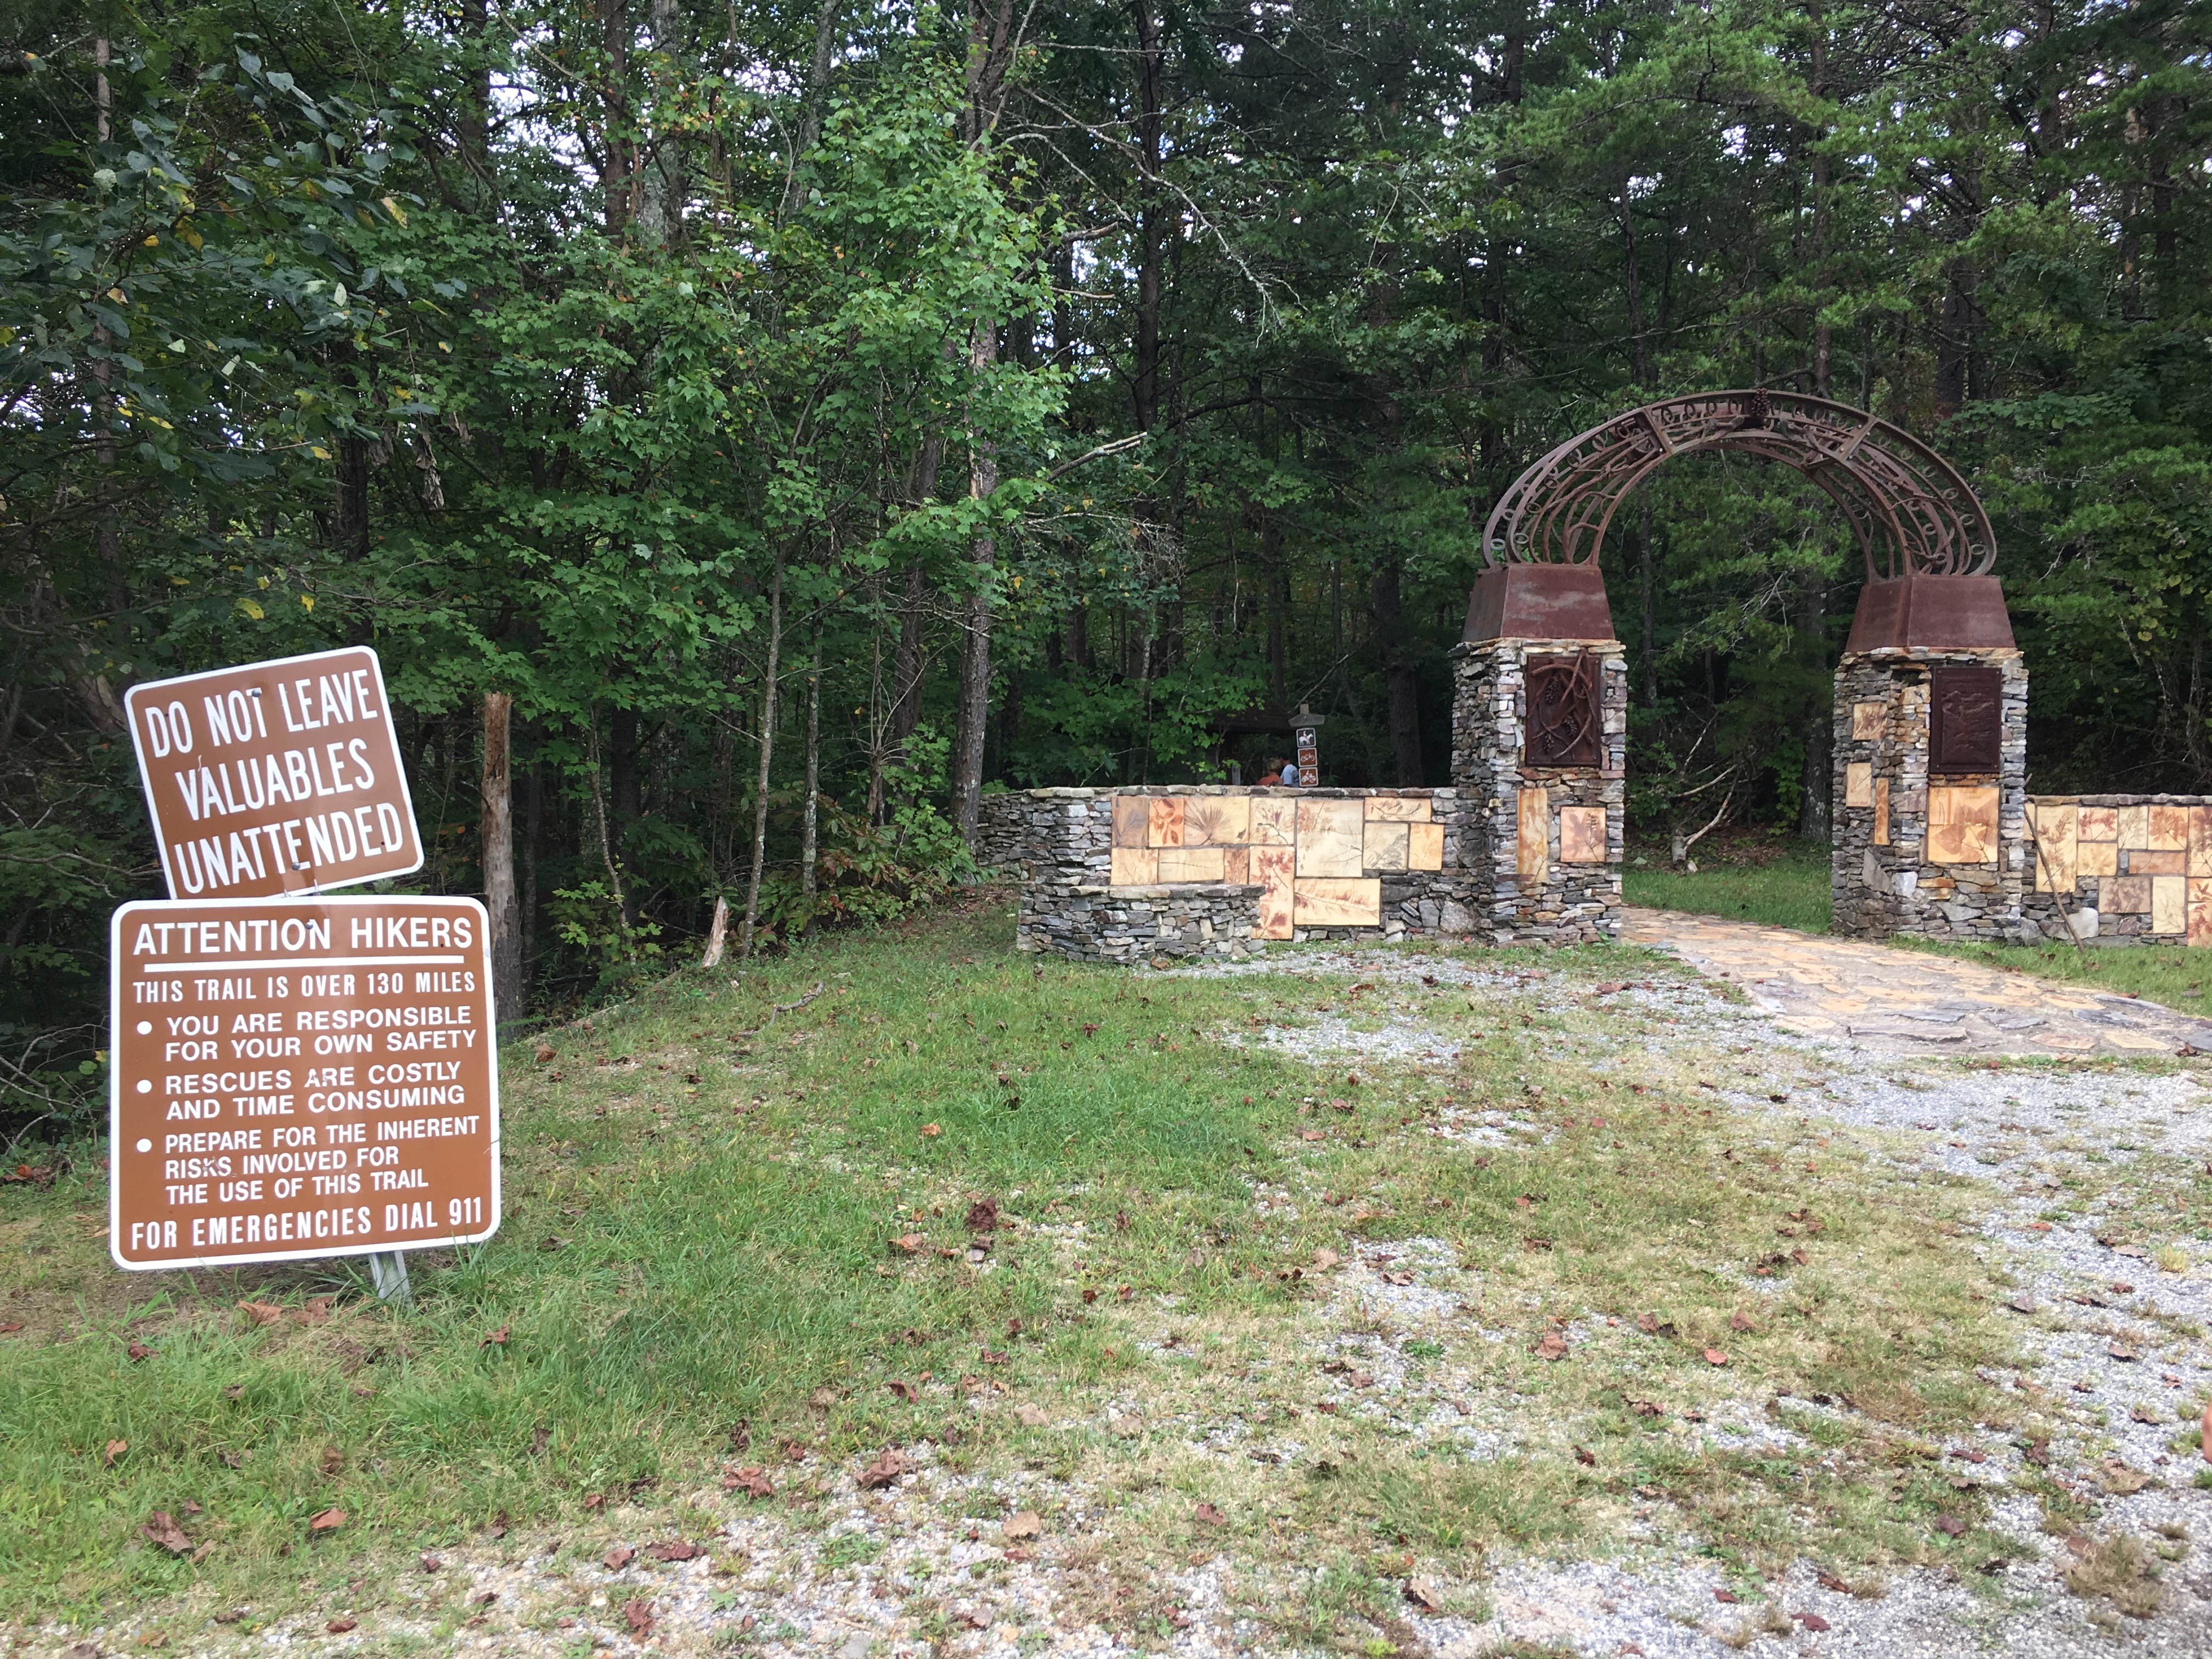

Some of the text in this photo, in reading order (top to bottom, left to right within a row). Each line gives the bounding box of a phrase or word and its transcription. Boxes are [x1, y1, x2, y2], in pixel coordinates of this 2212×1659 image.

[145, 669, 377, 757] DO NOT LEAVE
[175, 738, 374, 820] VALUABLES
[175, 803, 403, 893] UNATTENDED
[133, 918, 472, 955] ATTENTION HIKERS
[133, 972, 475, 1003] THIS TRAIL IS OVER 130 MILES
[167, 1006, 471, 1035] YOU ARE RESPONSIBLE
[166, 1030, 476, 1061] FOR YOUR OWN SAFETY
[166, 1062, 460, 1094] RESCUES ARE COSTLY
[167, 1085, 464, 1120] AND TIME CONSUMING
[166, 1116, 479, 1153] PREPARE FOR THE INHERENT
[166, 1146, 398, 1179] RISKS INVOLVED FOR
[166, 1169, 428, 1204] THE USE OF THIS TRAIL
[132, 1197, 481, 1250] FOR EMERGENCIES DIAL 911
